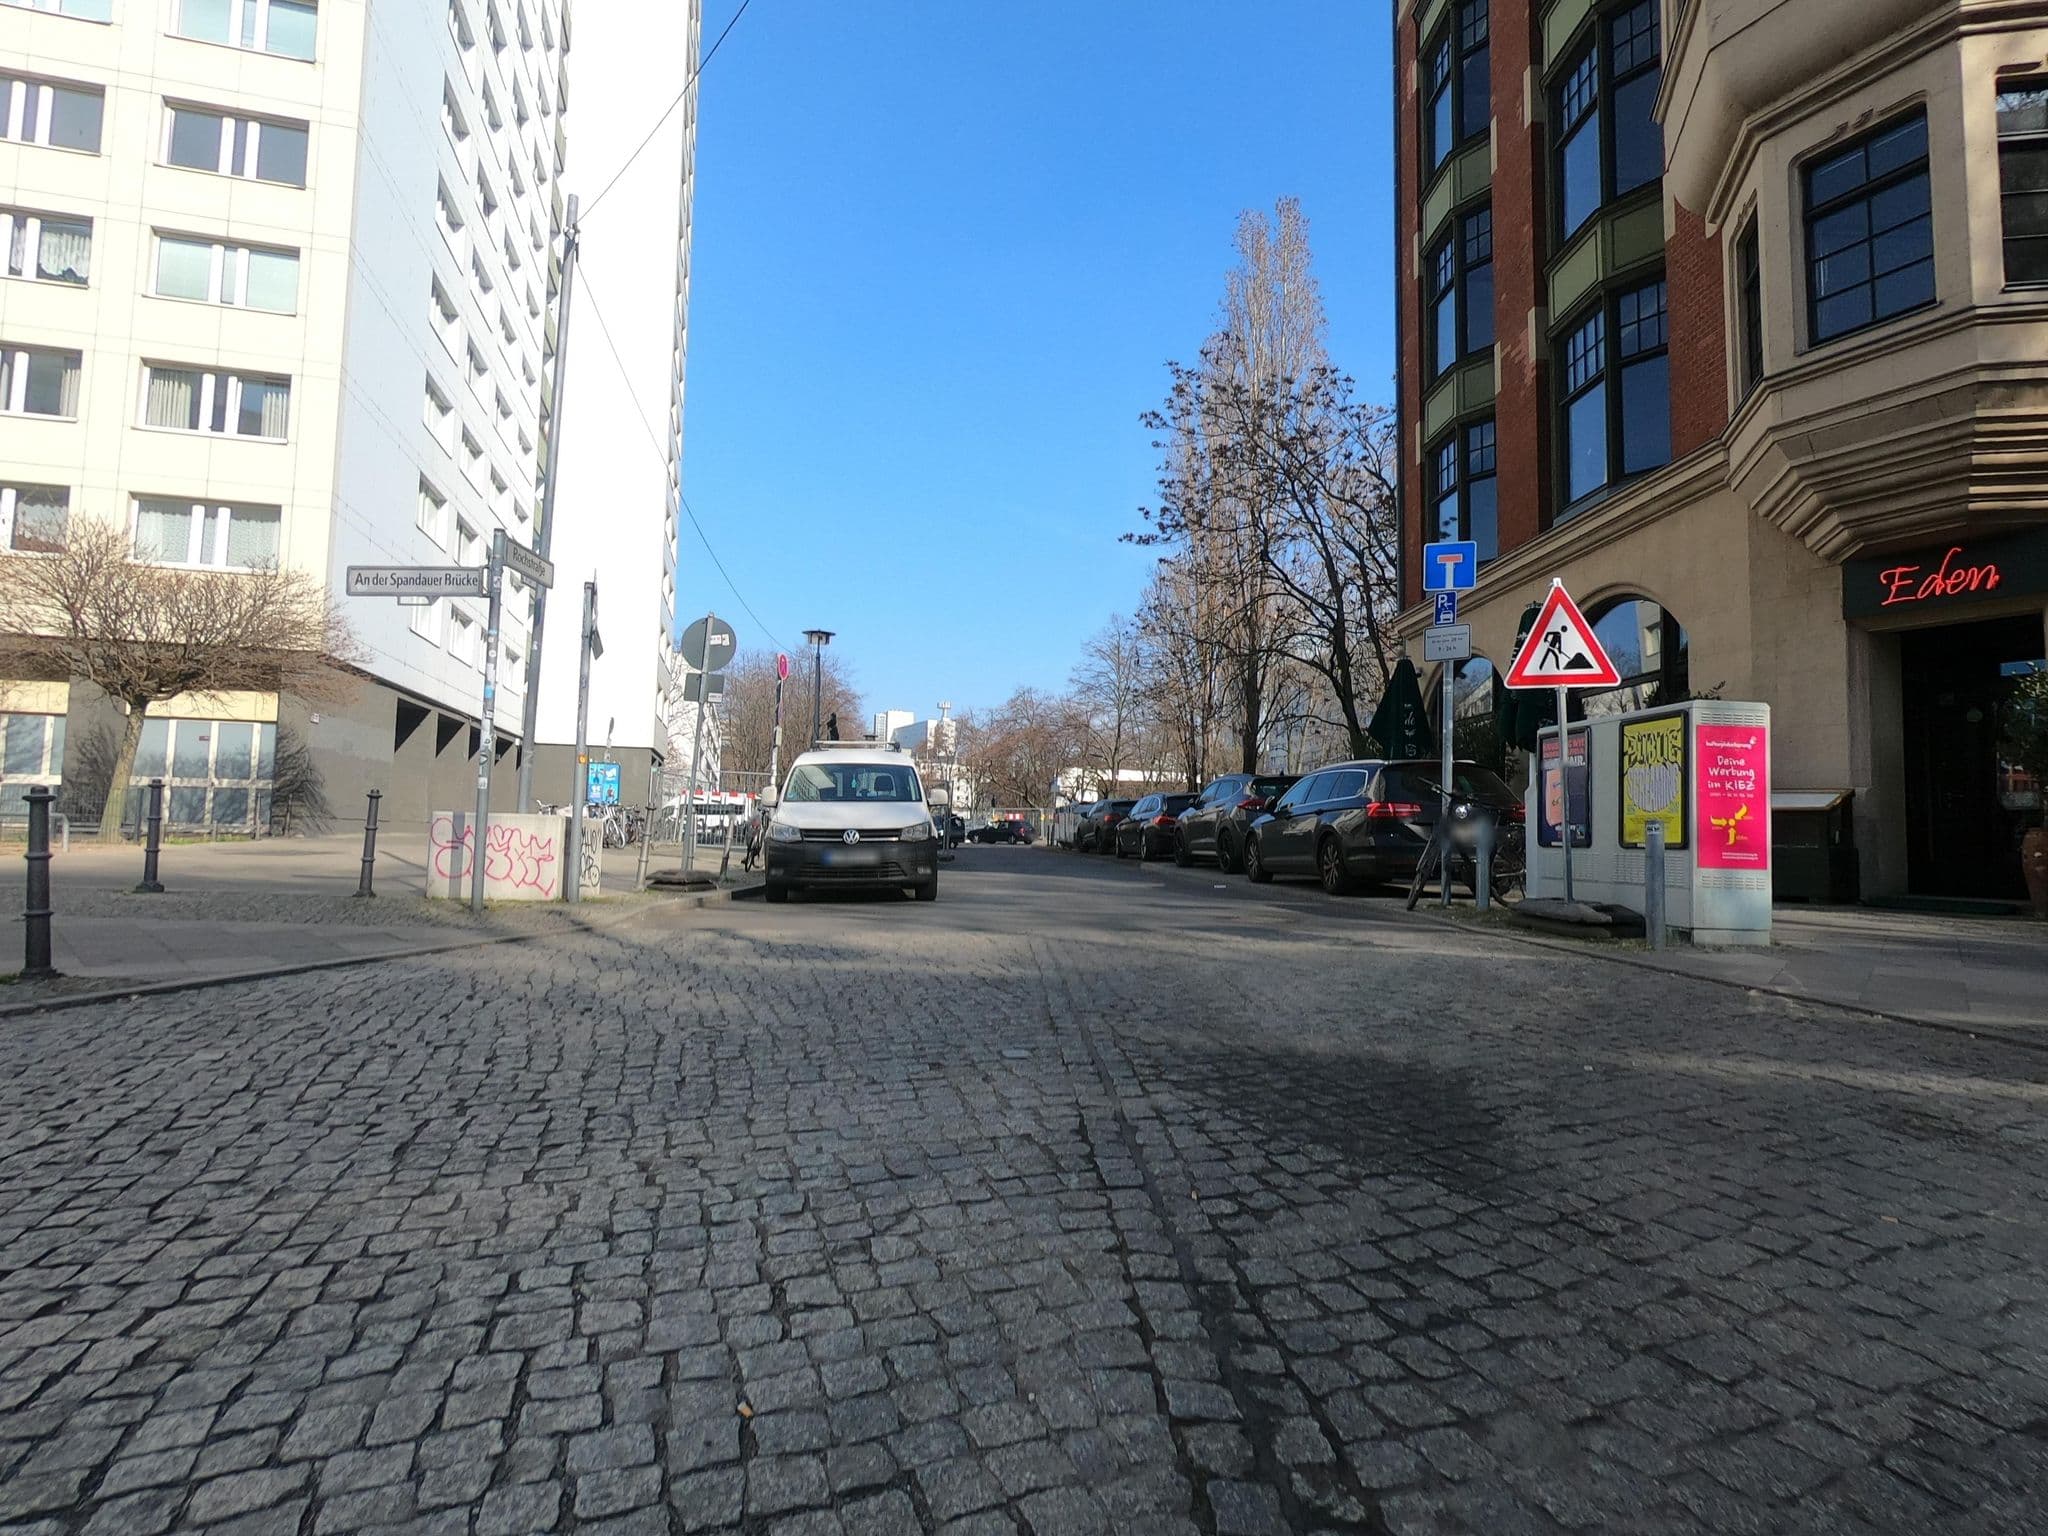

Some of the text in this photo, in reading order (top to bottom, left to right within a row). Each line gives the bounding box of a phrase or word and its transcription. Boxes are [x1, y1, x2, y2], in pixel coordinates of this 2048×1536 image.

[512, 546, 546, 577] Rochstraße
[354, 572, 478, 588] An der Spandauer Brücke
[1880, 547, 2000, 606] Eden
[1438, 594, 1448, 608] P
[1717, 755, 1746, 766] Deine
[1708, 766, 1755, 781] Werbung
[1707, 780, 1755, 791] im KIEZ
